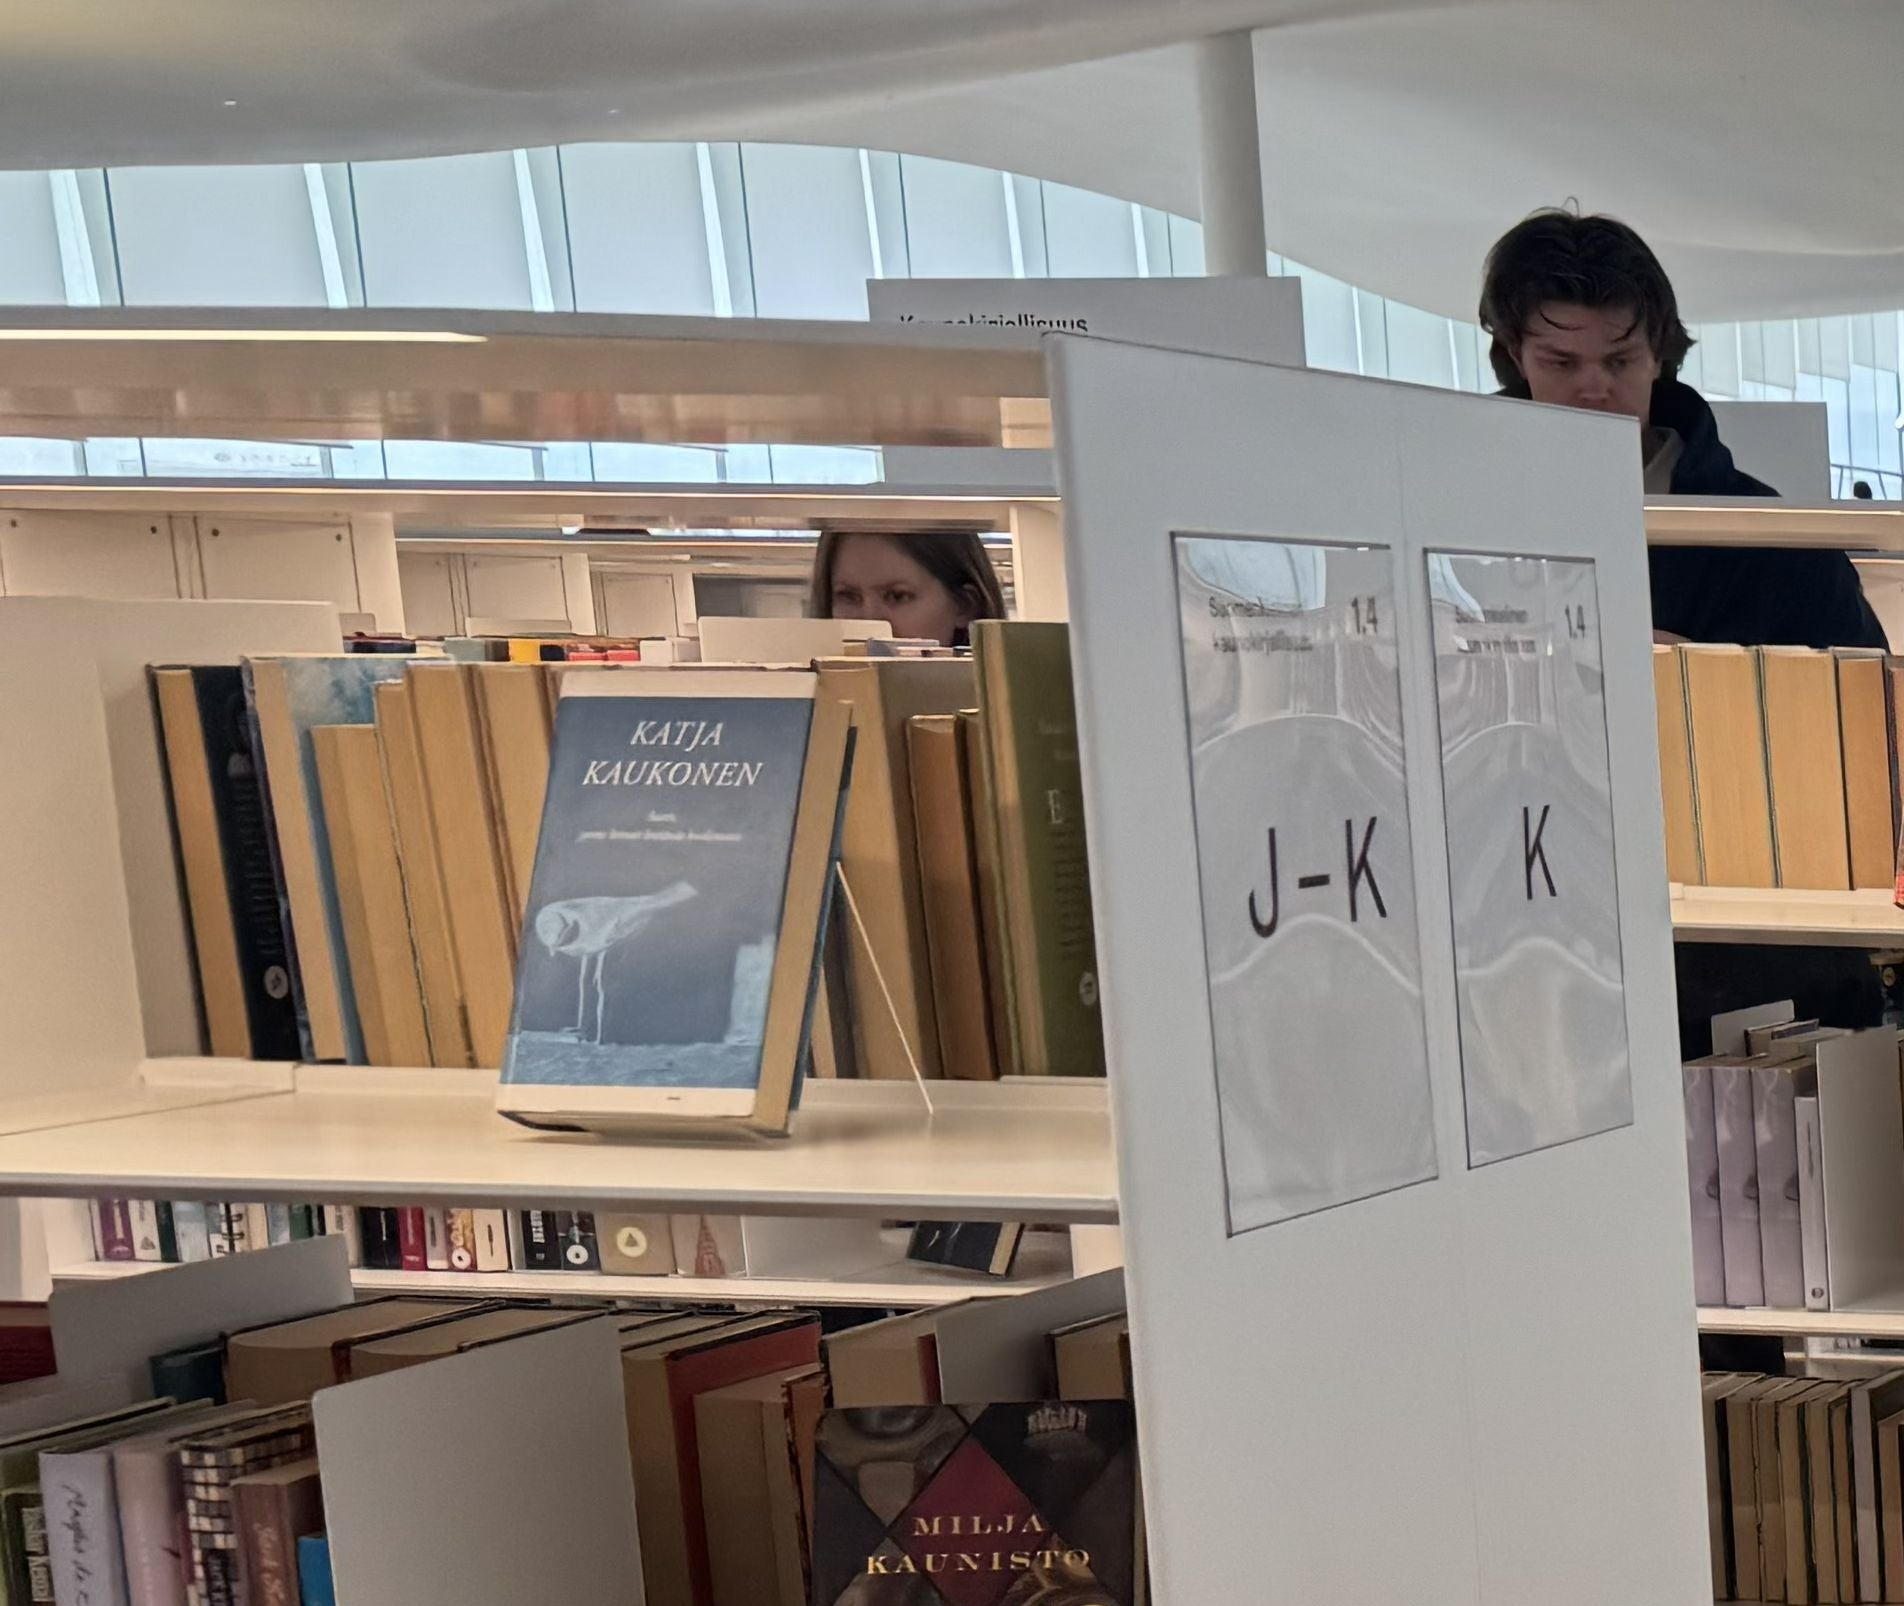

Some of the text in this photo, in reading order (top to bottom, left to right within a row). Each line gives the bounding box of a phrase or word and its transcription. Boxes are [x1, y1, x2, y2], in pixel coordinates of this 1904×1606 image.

[630, 720, 724, 752] KATJA
[582, 760, 763, 786] KAUKONEN
[1523, 804, 1557, 900] K
[912, 1514, 1047, 1536] MILJA
[867, 1550, 1090, 1575] KAUNISTO
